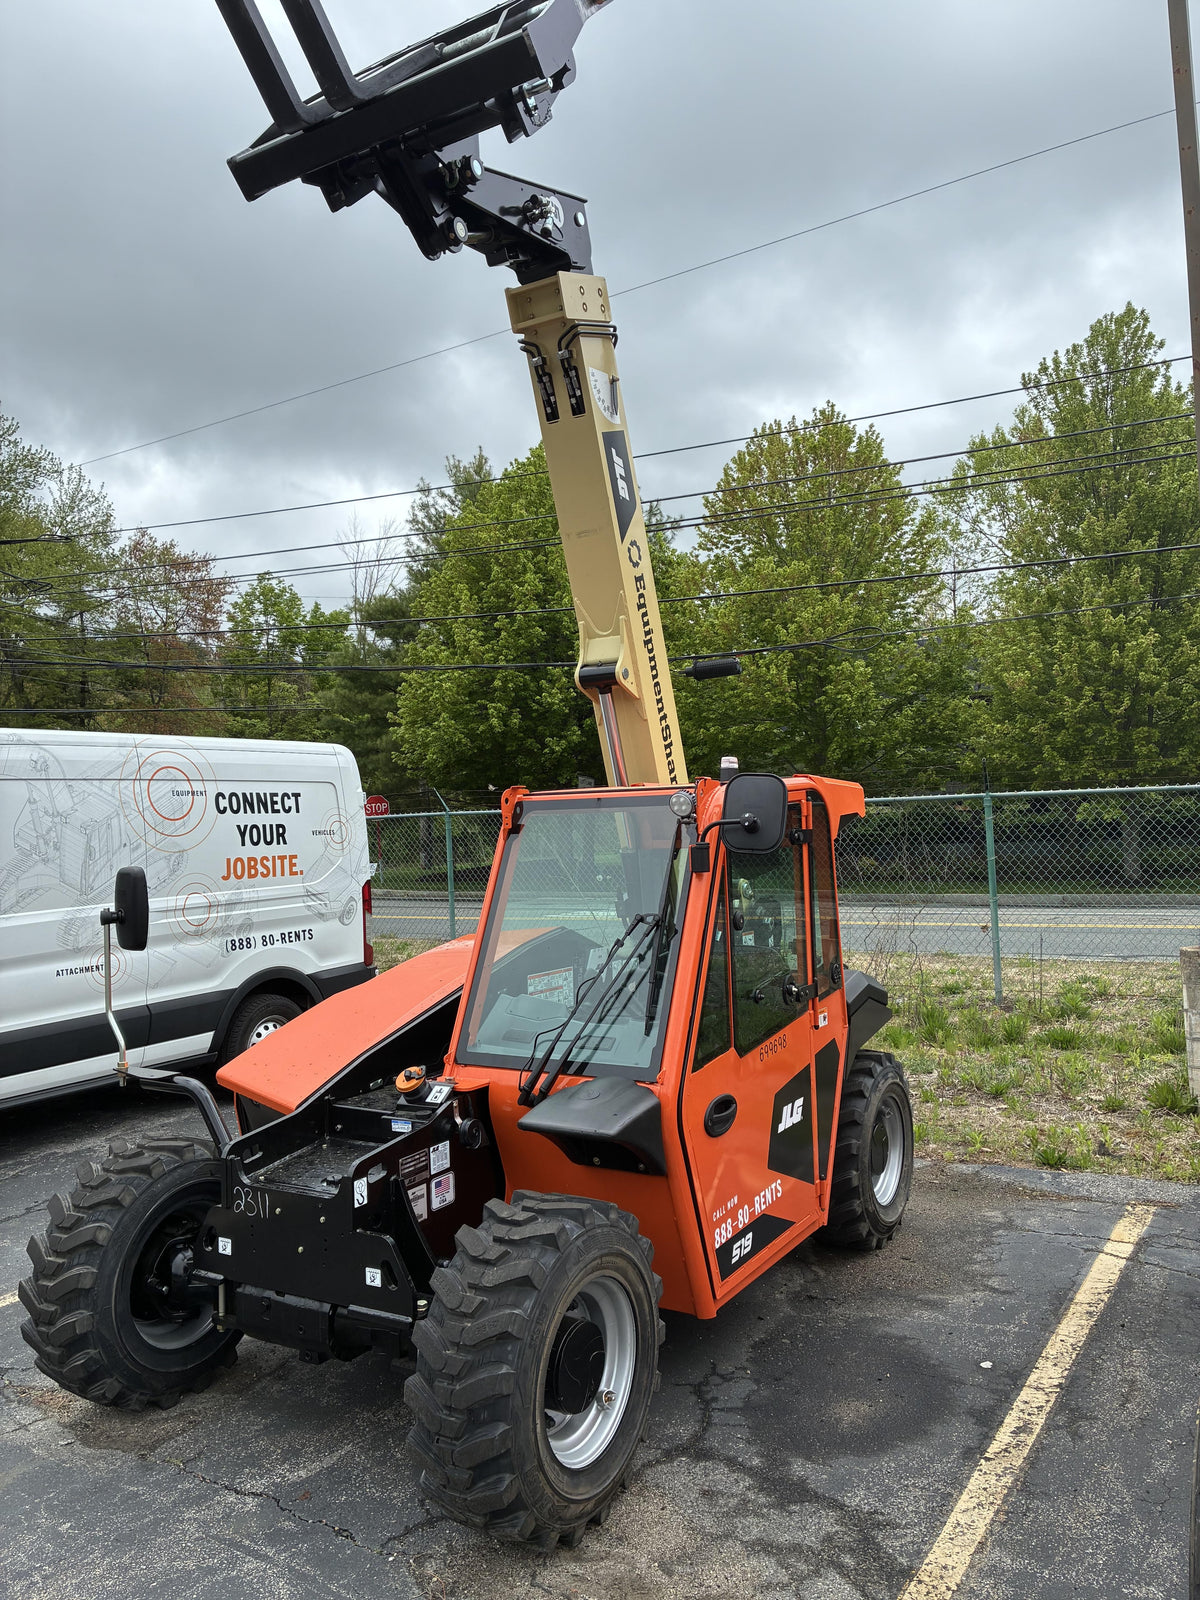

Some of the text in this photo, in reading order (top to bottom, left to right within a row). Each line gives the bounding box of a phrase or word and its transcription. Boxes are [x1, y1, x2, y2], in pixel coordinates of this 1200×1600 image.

[611, 447, 630, 501] JLG
[214, 791, 301, 815] CONNECT
[365, 802, 388, 814] STOP
[236, 823, 288, 847] YOUR
[311, 829, 335, 837] VEHICLES
[221, 854, 304, 881] JOBSITE.
[225, 928, 314, 953] (888) 80-RENTS
[759, 1033, 787, 1062] 699698
[777, 1096, 804, 1134] JLG
[233, 1186, 269, 1219] 2311
[712, 1194, 738, 1222] CALL NOW
[714, 1178, 783, 1249] 888-80-RENTS
[731, 1231, 753, 1265] 519
